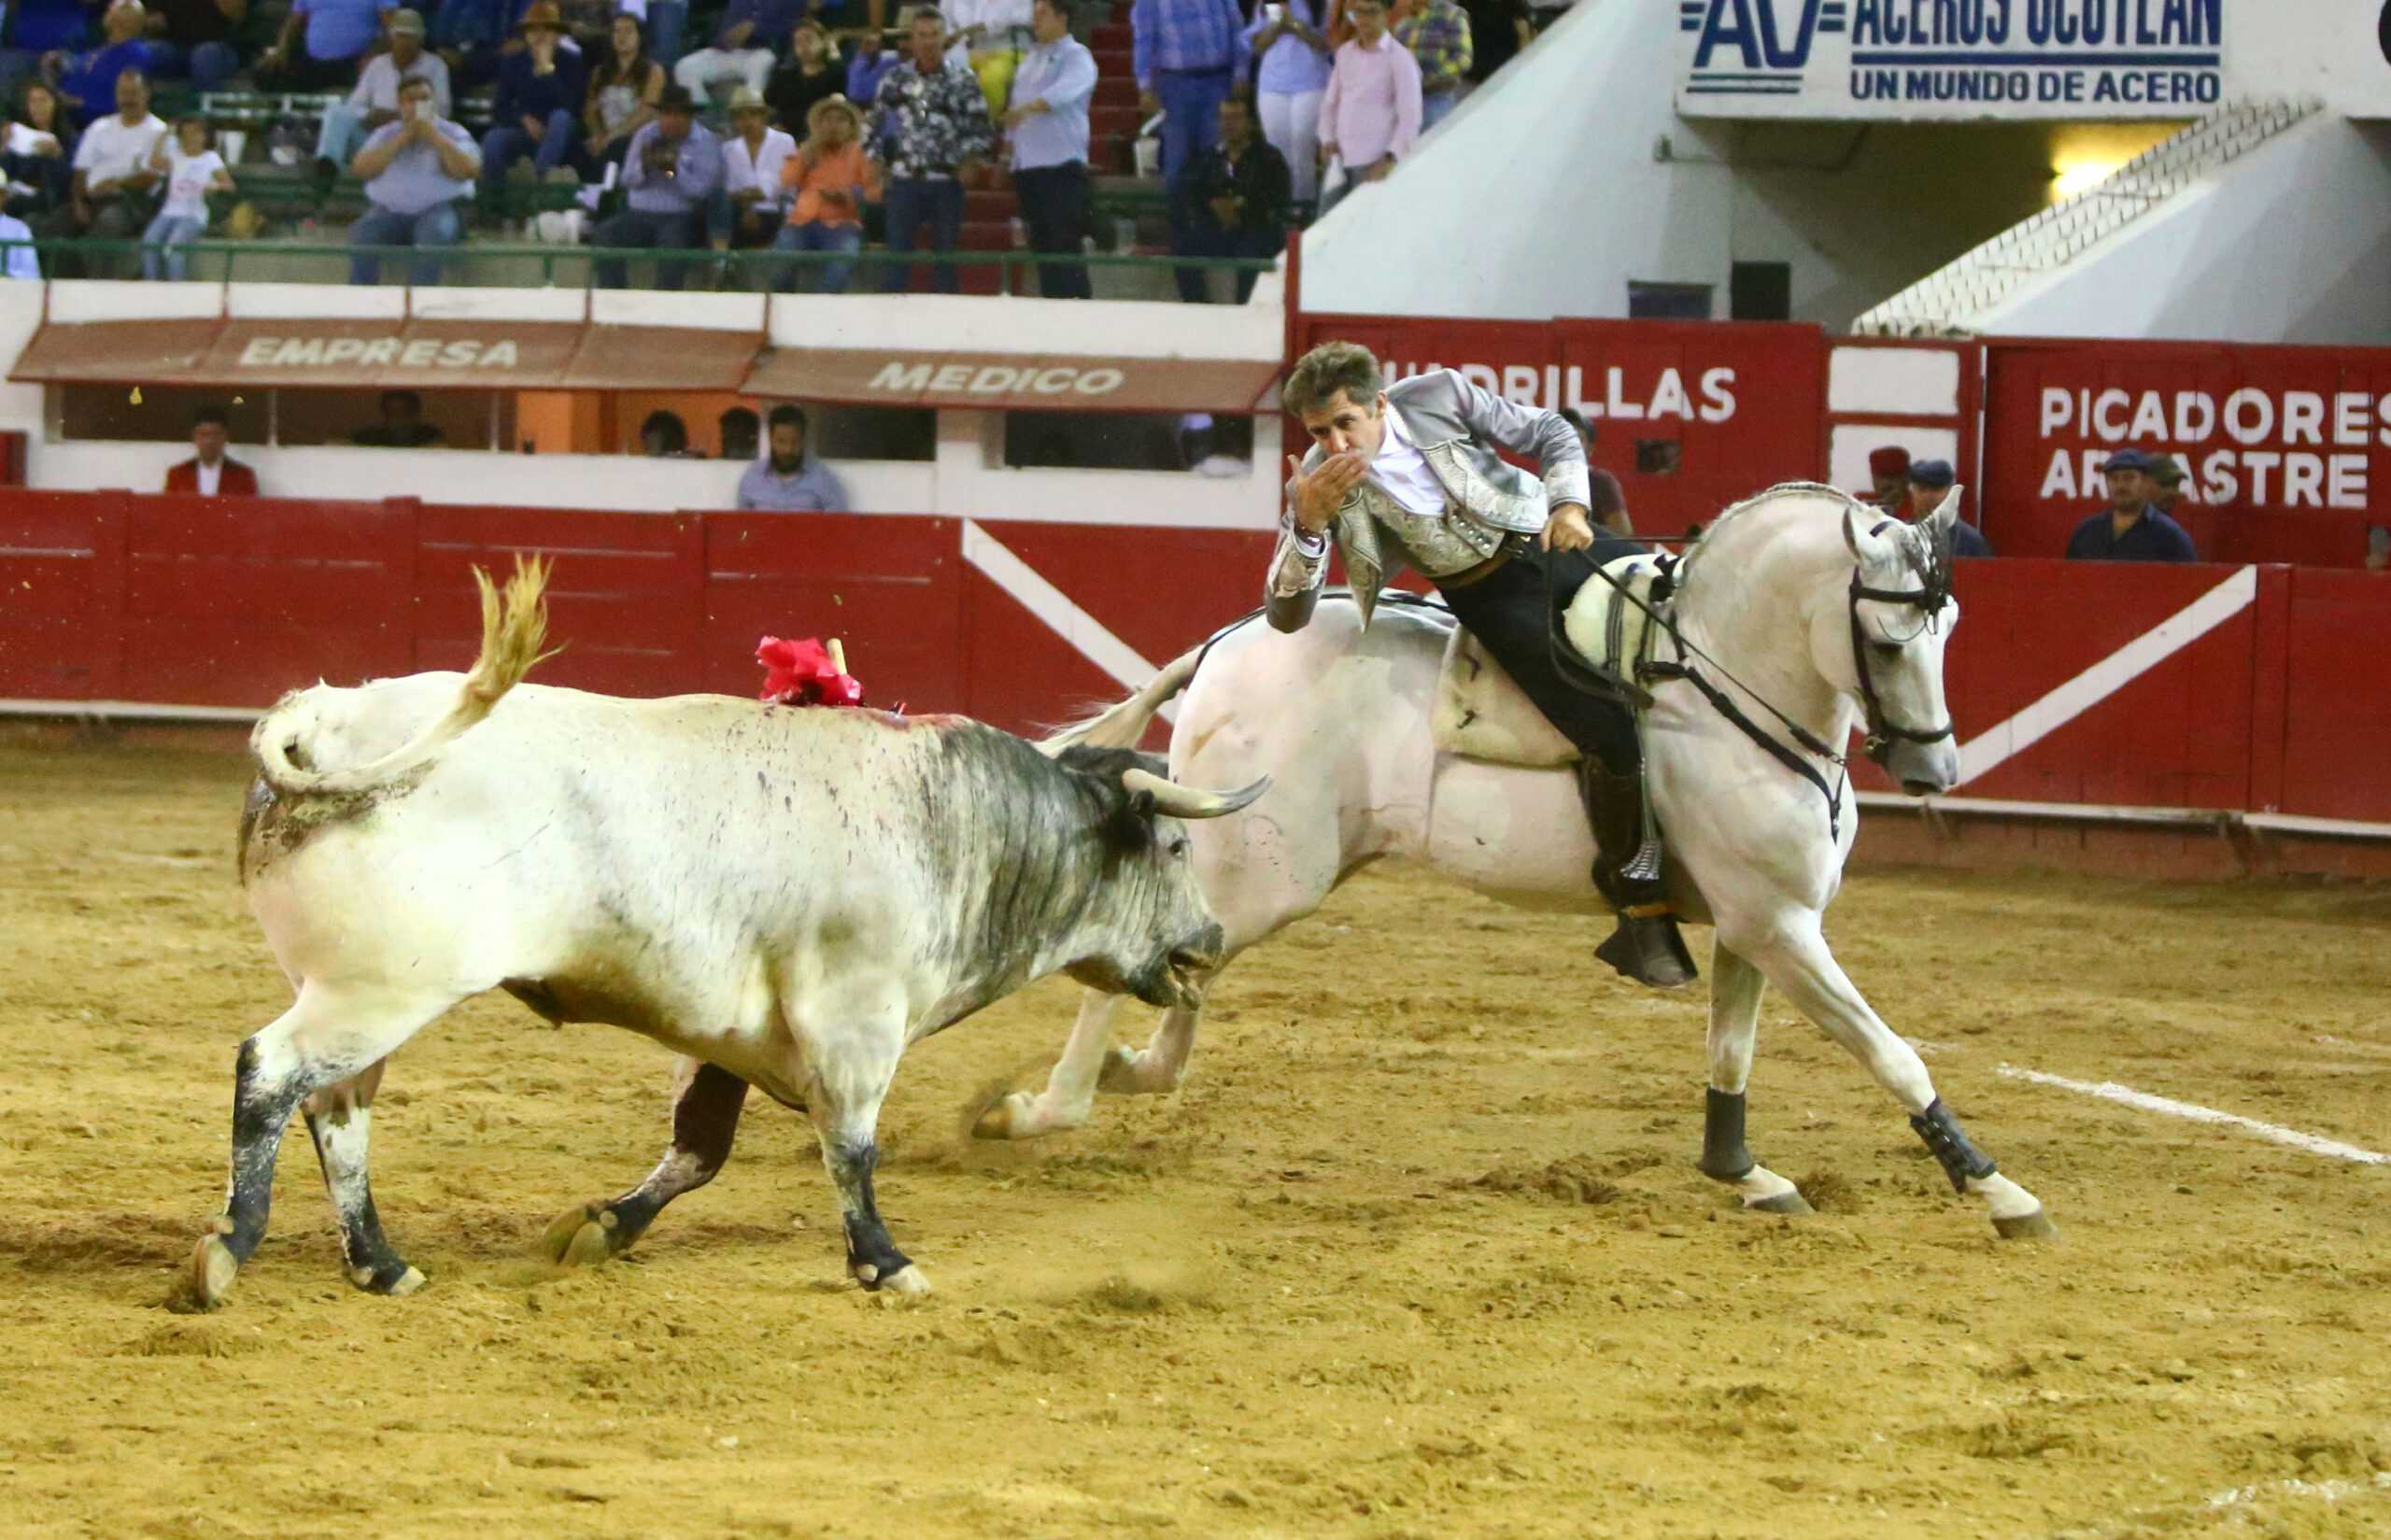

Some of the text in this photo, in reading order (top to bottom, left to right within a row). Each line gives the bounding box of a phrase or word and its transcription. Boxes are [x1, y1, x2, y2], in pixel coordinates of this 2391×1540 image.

[1852, 0, 2221, 46] ACEROS OCOTLAN
[1850, 70, 2221, 103] UN MUNDO DE ACERO
[239, 336, 517, 368] EMPRESA
[868, 361, 1125, 395] MEDICO
[2040, 448, 2369, 509] ARASTRE
